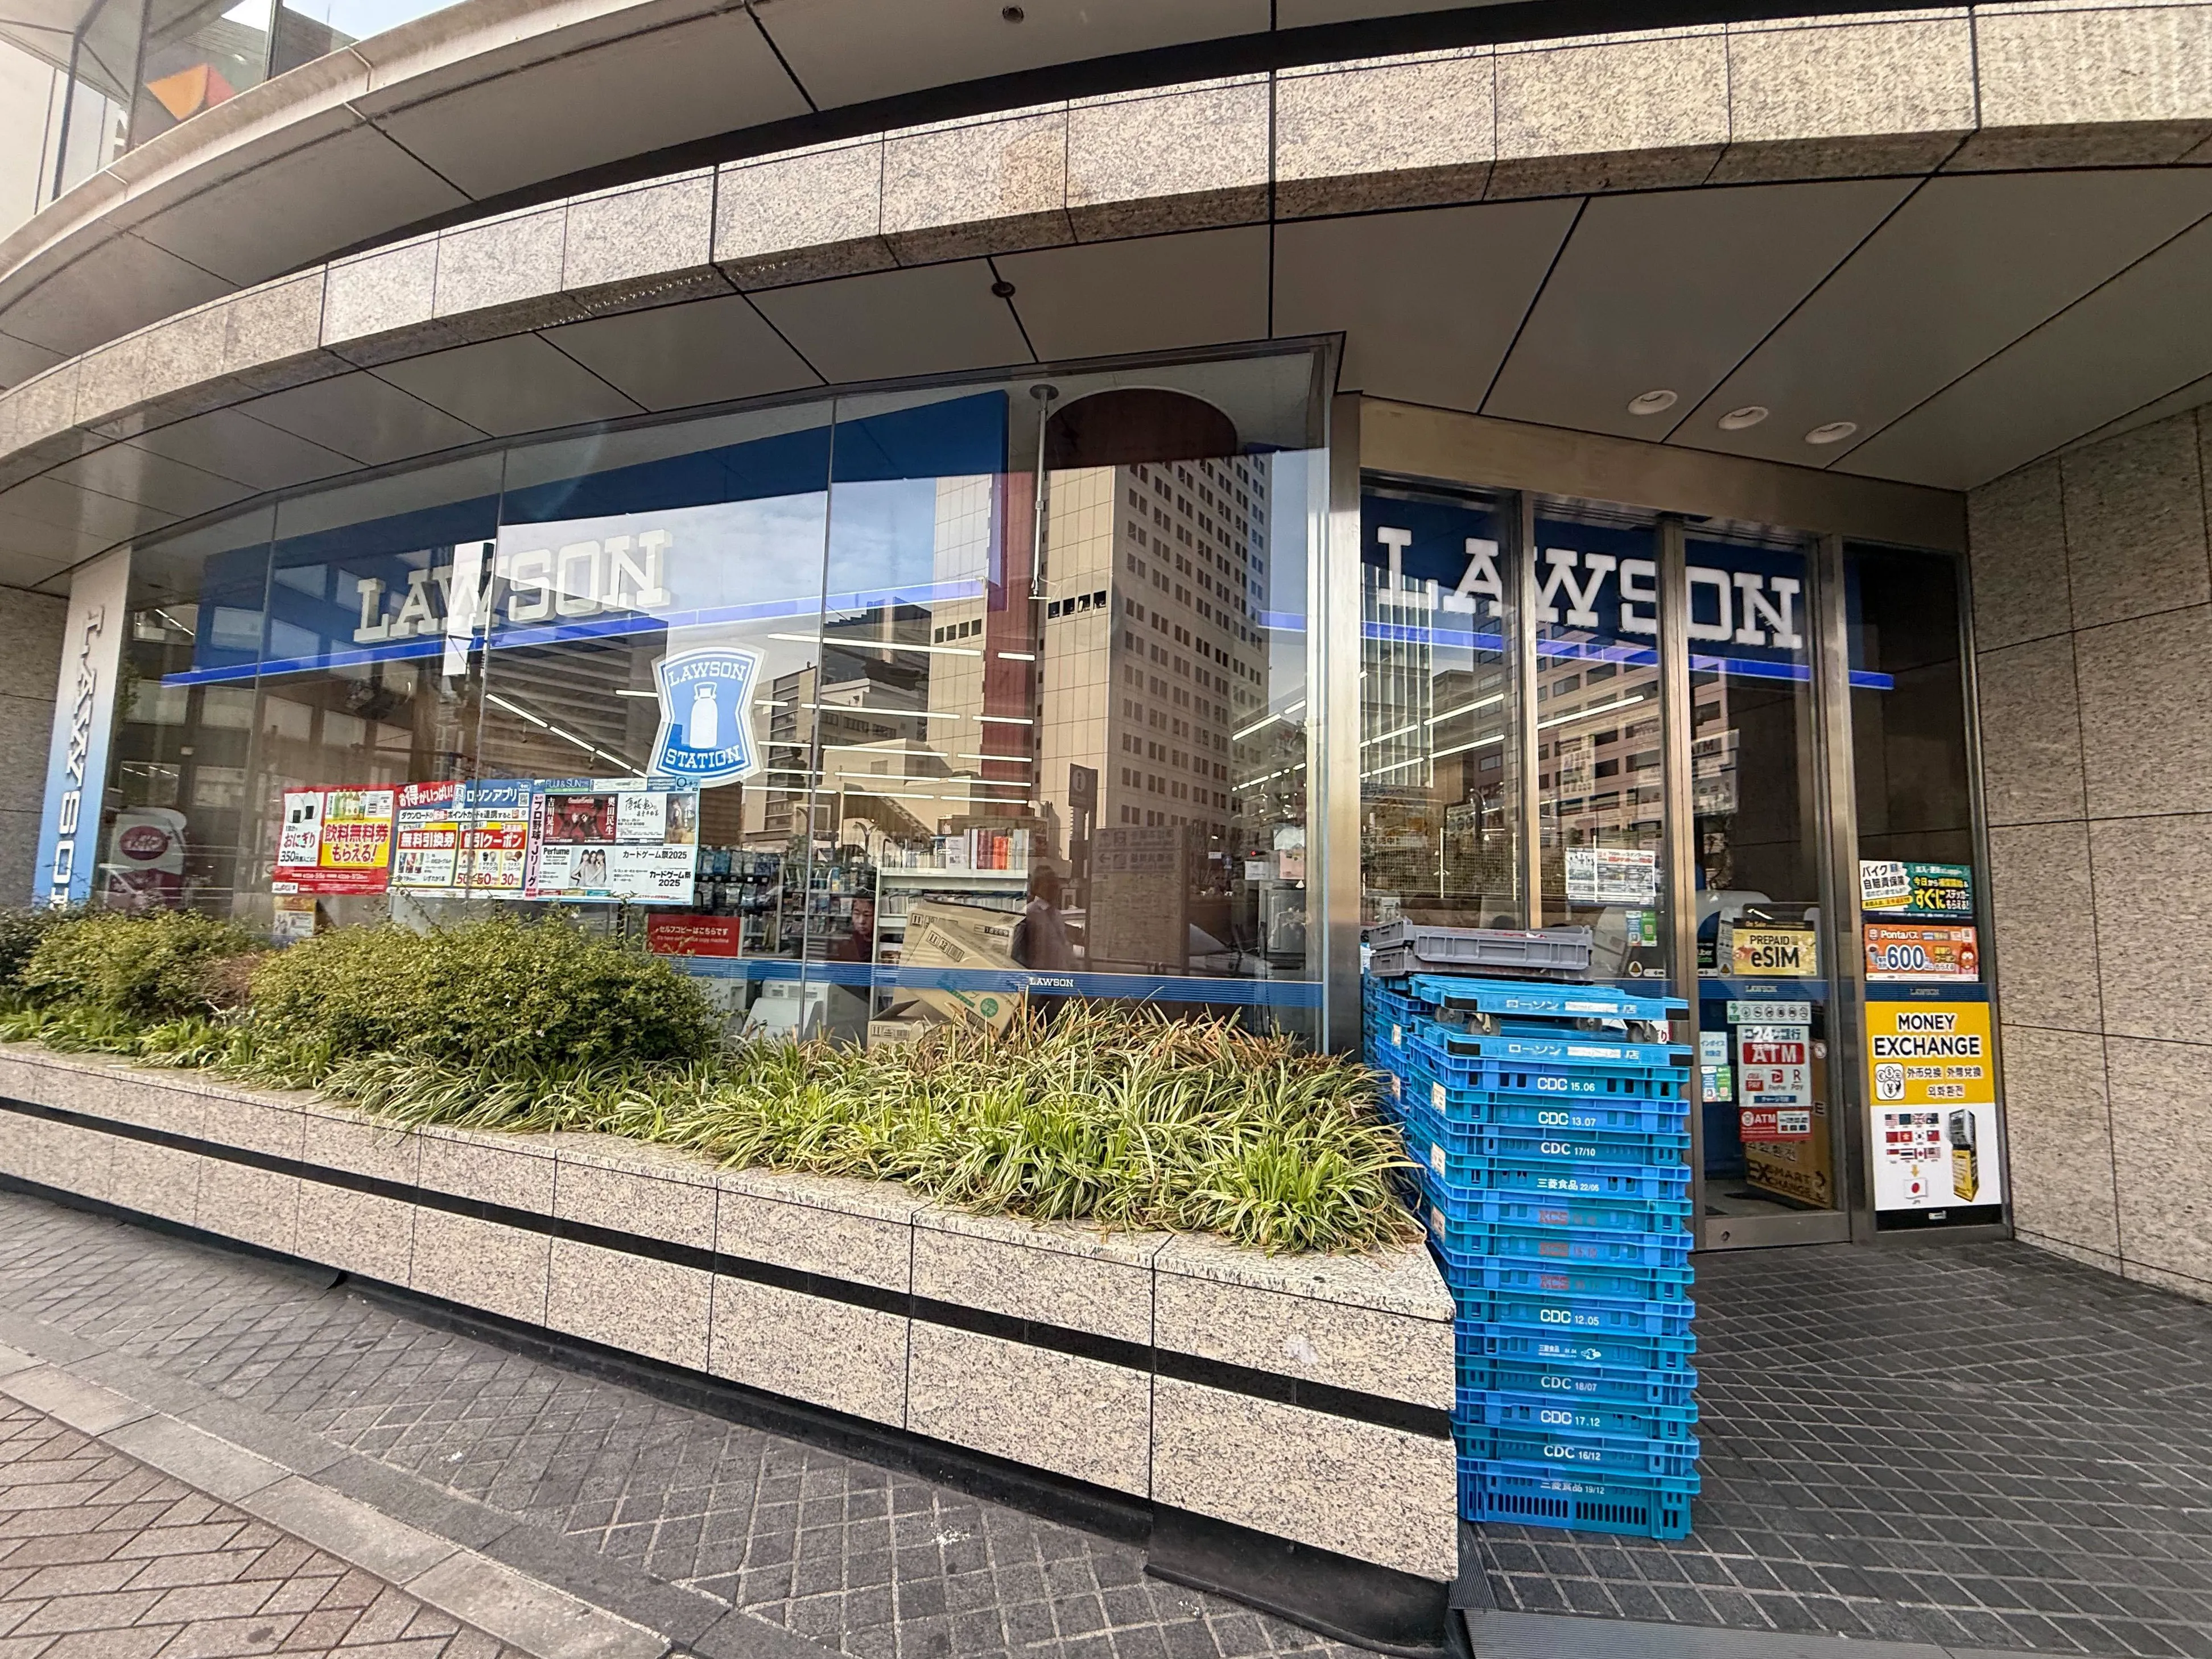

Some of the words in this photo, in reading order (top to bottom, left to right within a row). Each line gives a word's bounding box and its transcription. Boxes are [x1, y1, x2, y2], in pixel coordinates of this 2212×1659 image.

[353, 530, 672, 642] LAWSON
[1377, 526, 1802, 649] LAWSON
[668, 661, 746, 687] LAWSON
[665, 745, 741, 769] STATION
[399, 785, 453, 807] お得がいっぱい!
[447, 810, 511, 819] ポイントカドを連携すると
[605, 797, 616, 836] 奥田民生
[284, 832, 315, 848] おにぎり
[325, 823, 388, 843] 飲料無料券
[400, 832, 455, 848] 無料引換券
[528, 801, 543, 886] プロ野球・Jリーグ
[332, 844, 378, 862] もらえる!
[622, 851, 687, 859] カードゲーム祭2025
[1863, 865, 1888, 877] バイク
[1864, 876, 1905, 890] 自賠責保険
[1914, 888, 1946, 909] すぐに
[659, 926, 729, 936] セルフコピーはこちらです
[1749, 935, 1789, 945] PREPAID
[1751, 946, 1800, 968] eSIM
[1887, 946, 1924, 968] 600
[1028, 978, 1074, 988] LAWSON
[1507, 1000, 1559, 1010] ローソン
[1623, 1005, 1637, 1014] 店
[1898, 1014, 1956, 1030] MONEY
[1509, 1045, 1562, 1055] ローソン
[1625, 1050, 1640, 1059] 店
[1752, 1044, 1797, 1063] ATM
[1874, 1037, 1980, 1056] EXCHANGE
[1537, 1078, 1568, 1091] CDC
[1570, 1082, 1595, 1092] 15.06
[1538, 1112, 1569, 1126] CDC
[1572, 1117, 1596, 1127] 13.07
[1754, 1114, 1776, 1124] ATM
[1541, 1142, 1571, 1155] CDC
[1574, 1147, 1596, 1157] 17/10
[1537, 1178, 1578, 1191] 三菱食品
[1540, 1309, 1571, 1323] CDC
[1574, 1315, 1599, 1326] 12.05
[1541, 1376, 1571, 1389] CDC
[1575, 1381, 1598, 1392] 18/07
[1541, 1410, 1572, 1424] CDC
[1575, 1416, 1600, 1427] 17.12
[1544, 1445, 1575, 1459] CDC
[1578, 1451, 1601, 1461] 16/12
[1584, 1485, 1605, 1495] 19/12
